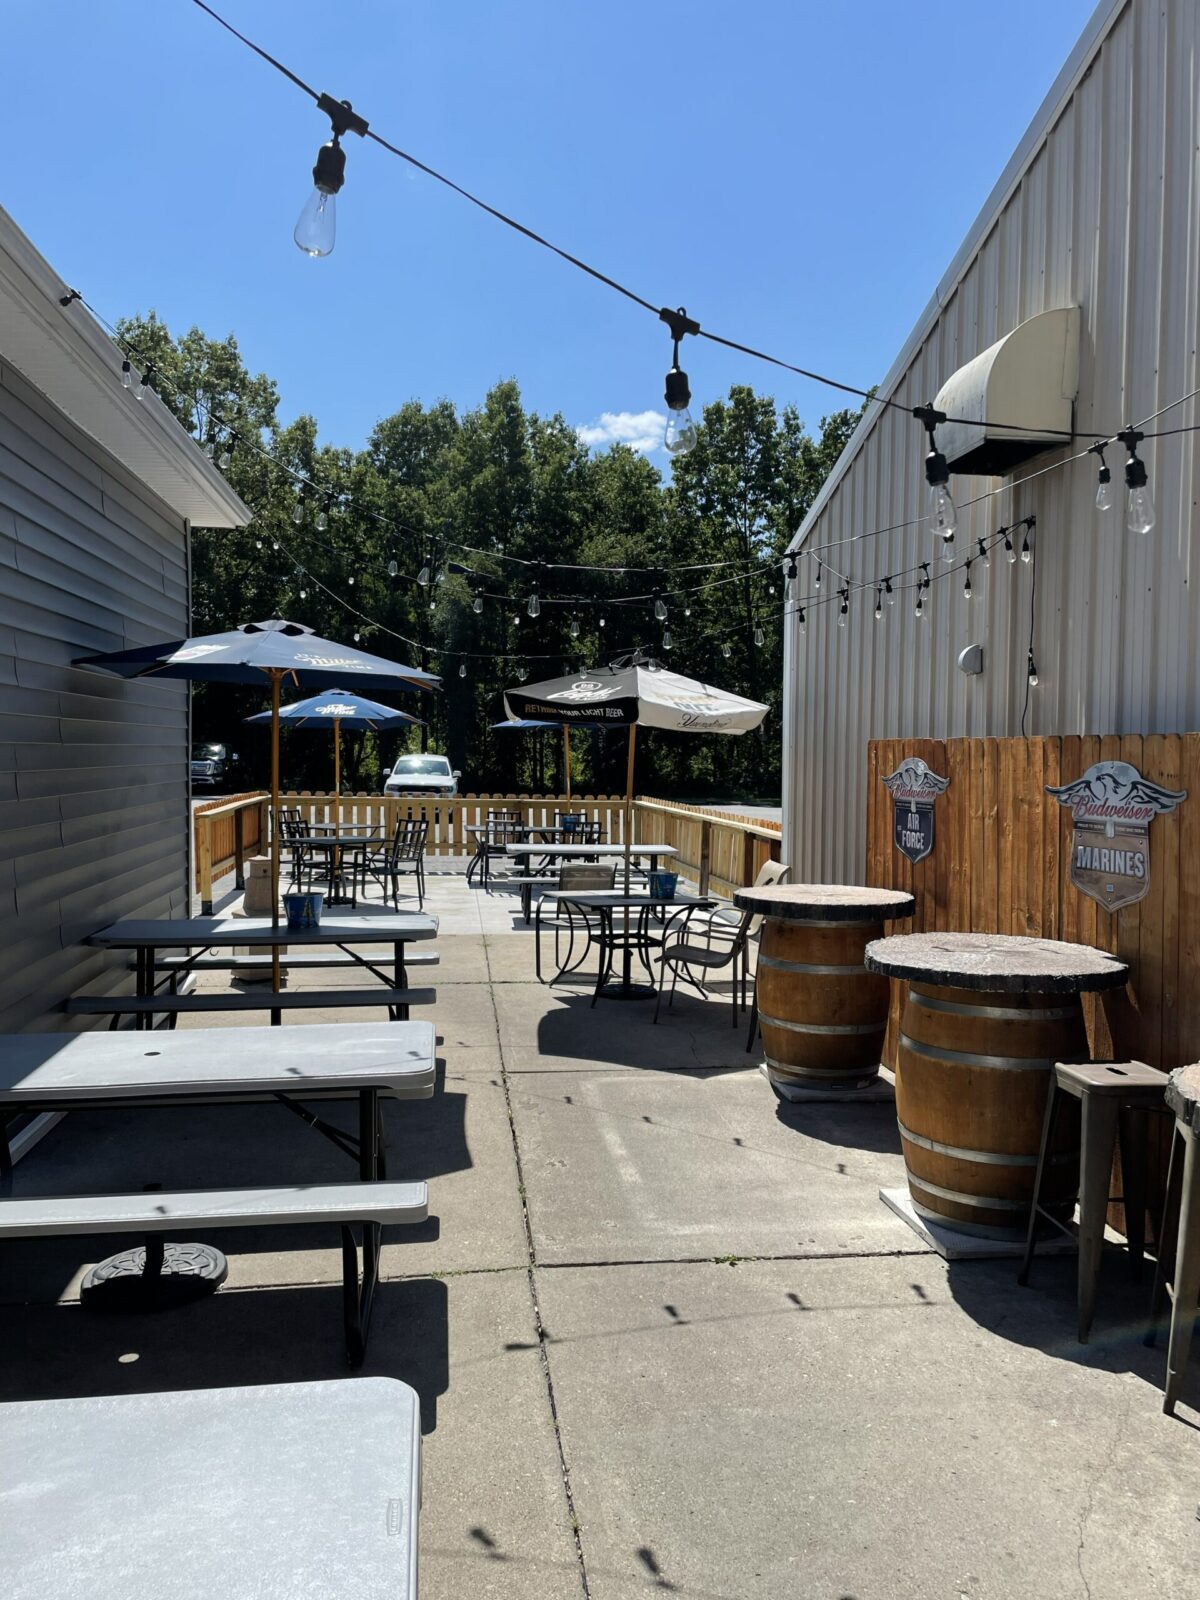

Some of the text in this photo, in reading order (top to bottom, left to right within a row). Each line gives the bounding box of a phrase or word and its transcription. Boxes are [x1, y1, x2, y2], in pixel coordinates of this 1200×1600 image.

[581, 708, 604, 717] LIGHT
[605, 707, 625, 718] BEER
[1071, 795, 1153, 820] Budweiser
[907, 812, 920, 831] AIR
[901, 830, 925, 850] FORCE
[1076, 845, 1145, 878] MARINES
